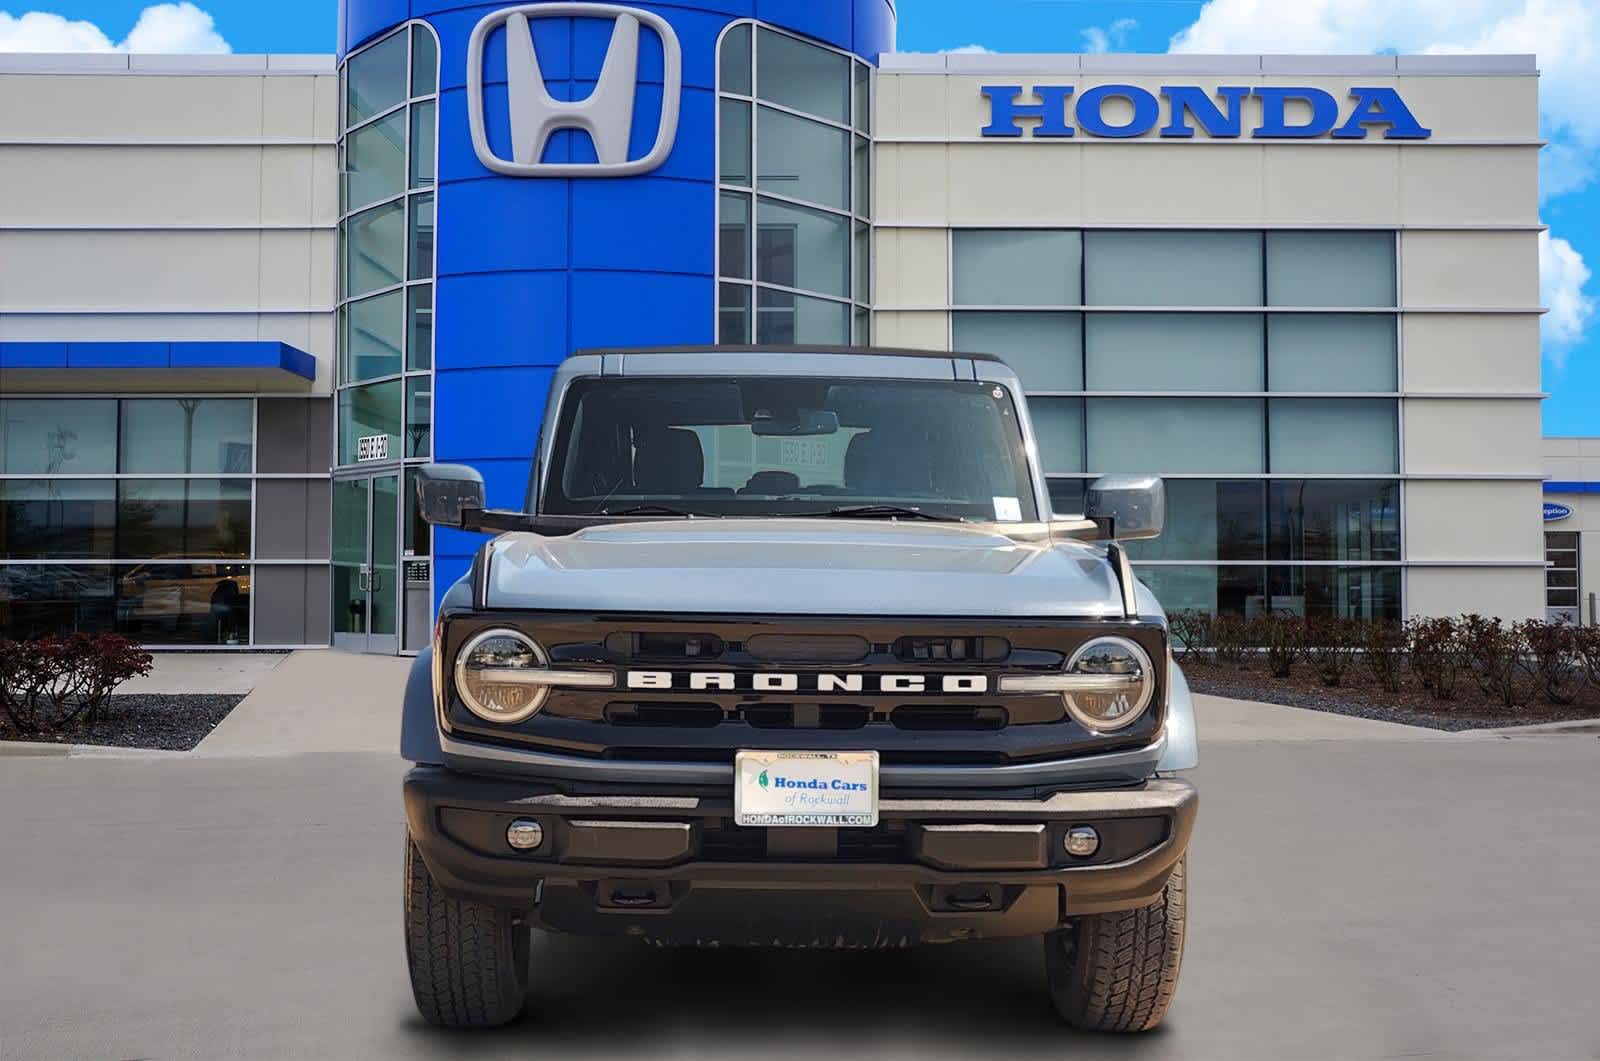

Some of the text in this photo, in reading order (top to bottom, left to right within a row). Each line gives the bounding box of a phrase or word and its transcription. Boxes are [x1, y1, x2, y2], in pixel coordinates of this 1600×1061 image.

[981, 84, 1432, 139] HONDA
[627, 671, 988, 693] BRONCO
[774, 776, 868, 791] Honda Cars
[785, 791, 850, 806] of Rockwall
